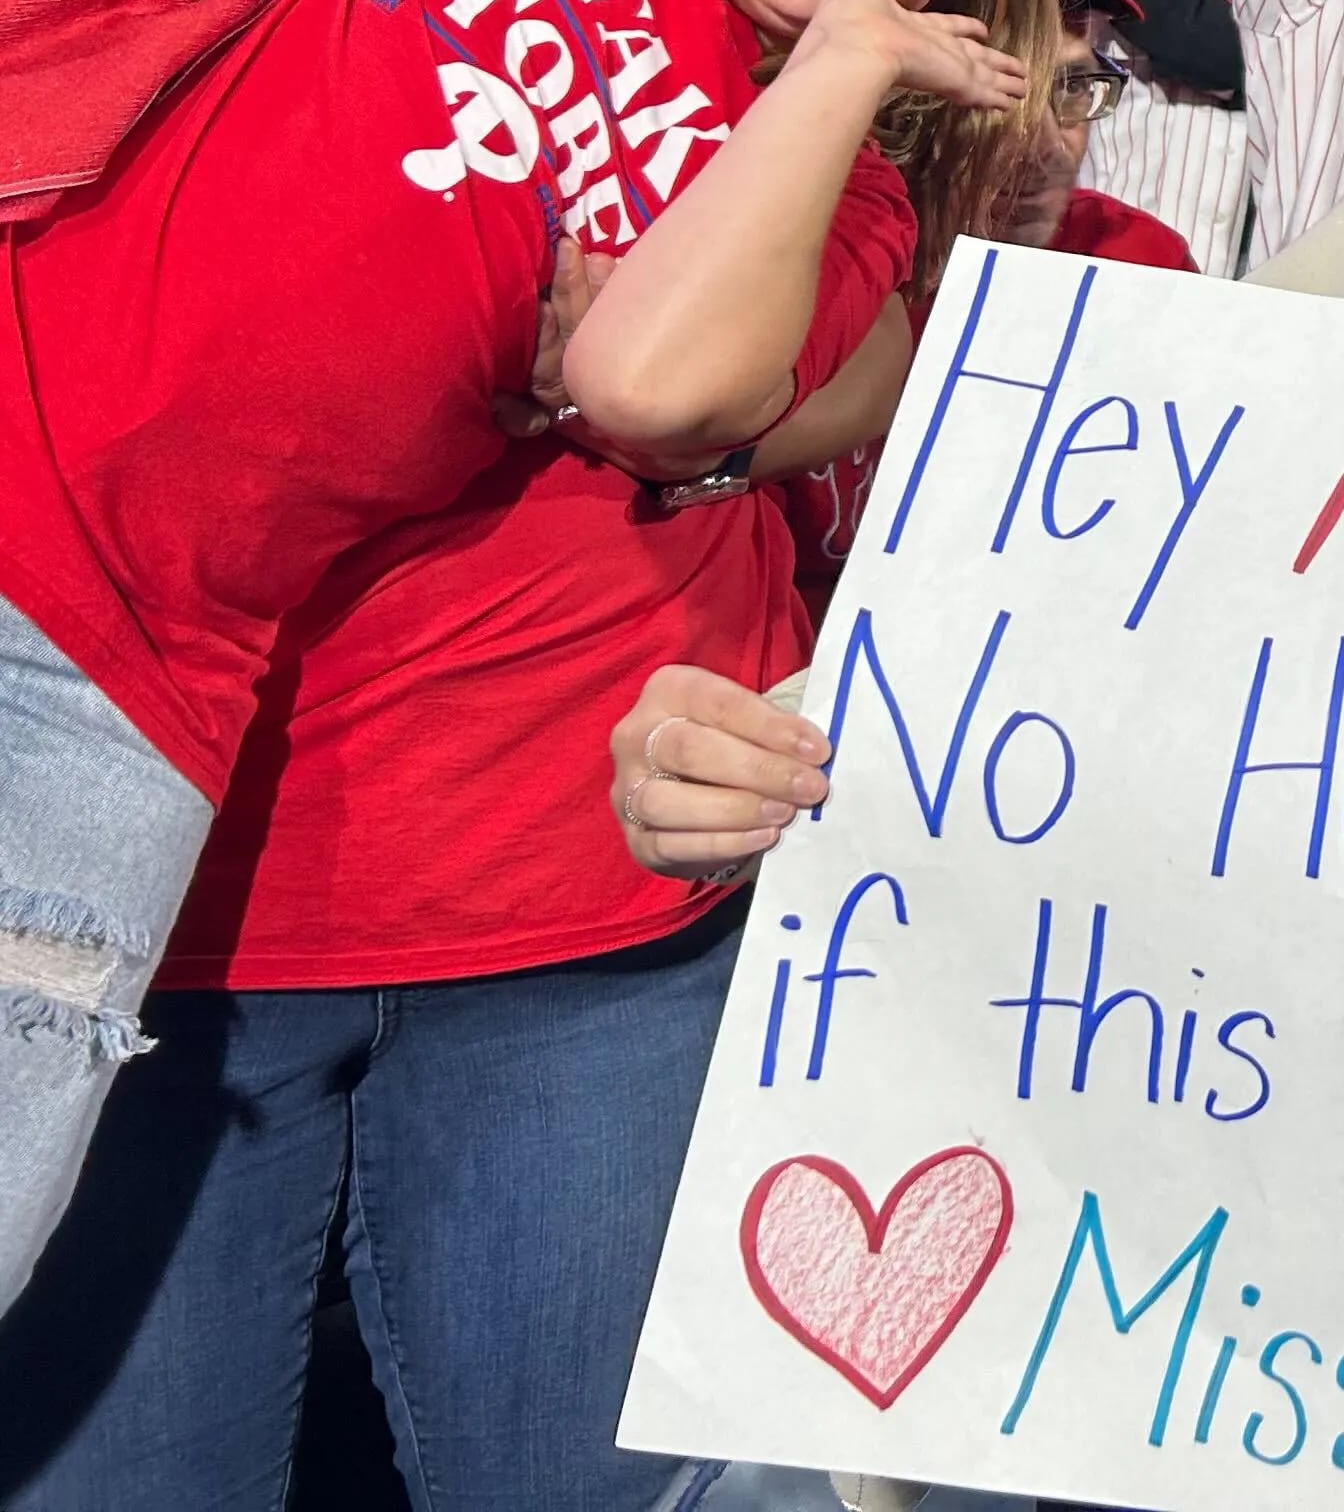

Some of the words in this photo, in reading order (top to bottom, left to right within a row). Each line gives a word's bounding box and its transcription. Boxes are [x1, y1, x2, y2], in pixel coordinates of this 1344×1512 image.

[885, 246, 1245, 630] Hey
[810, 608, 1077, 845] No
[758, 872, 909, 1089] if
[990, 899, 1276, 1123] this
